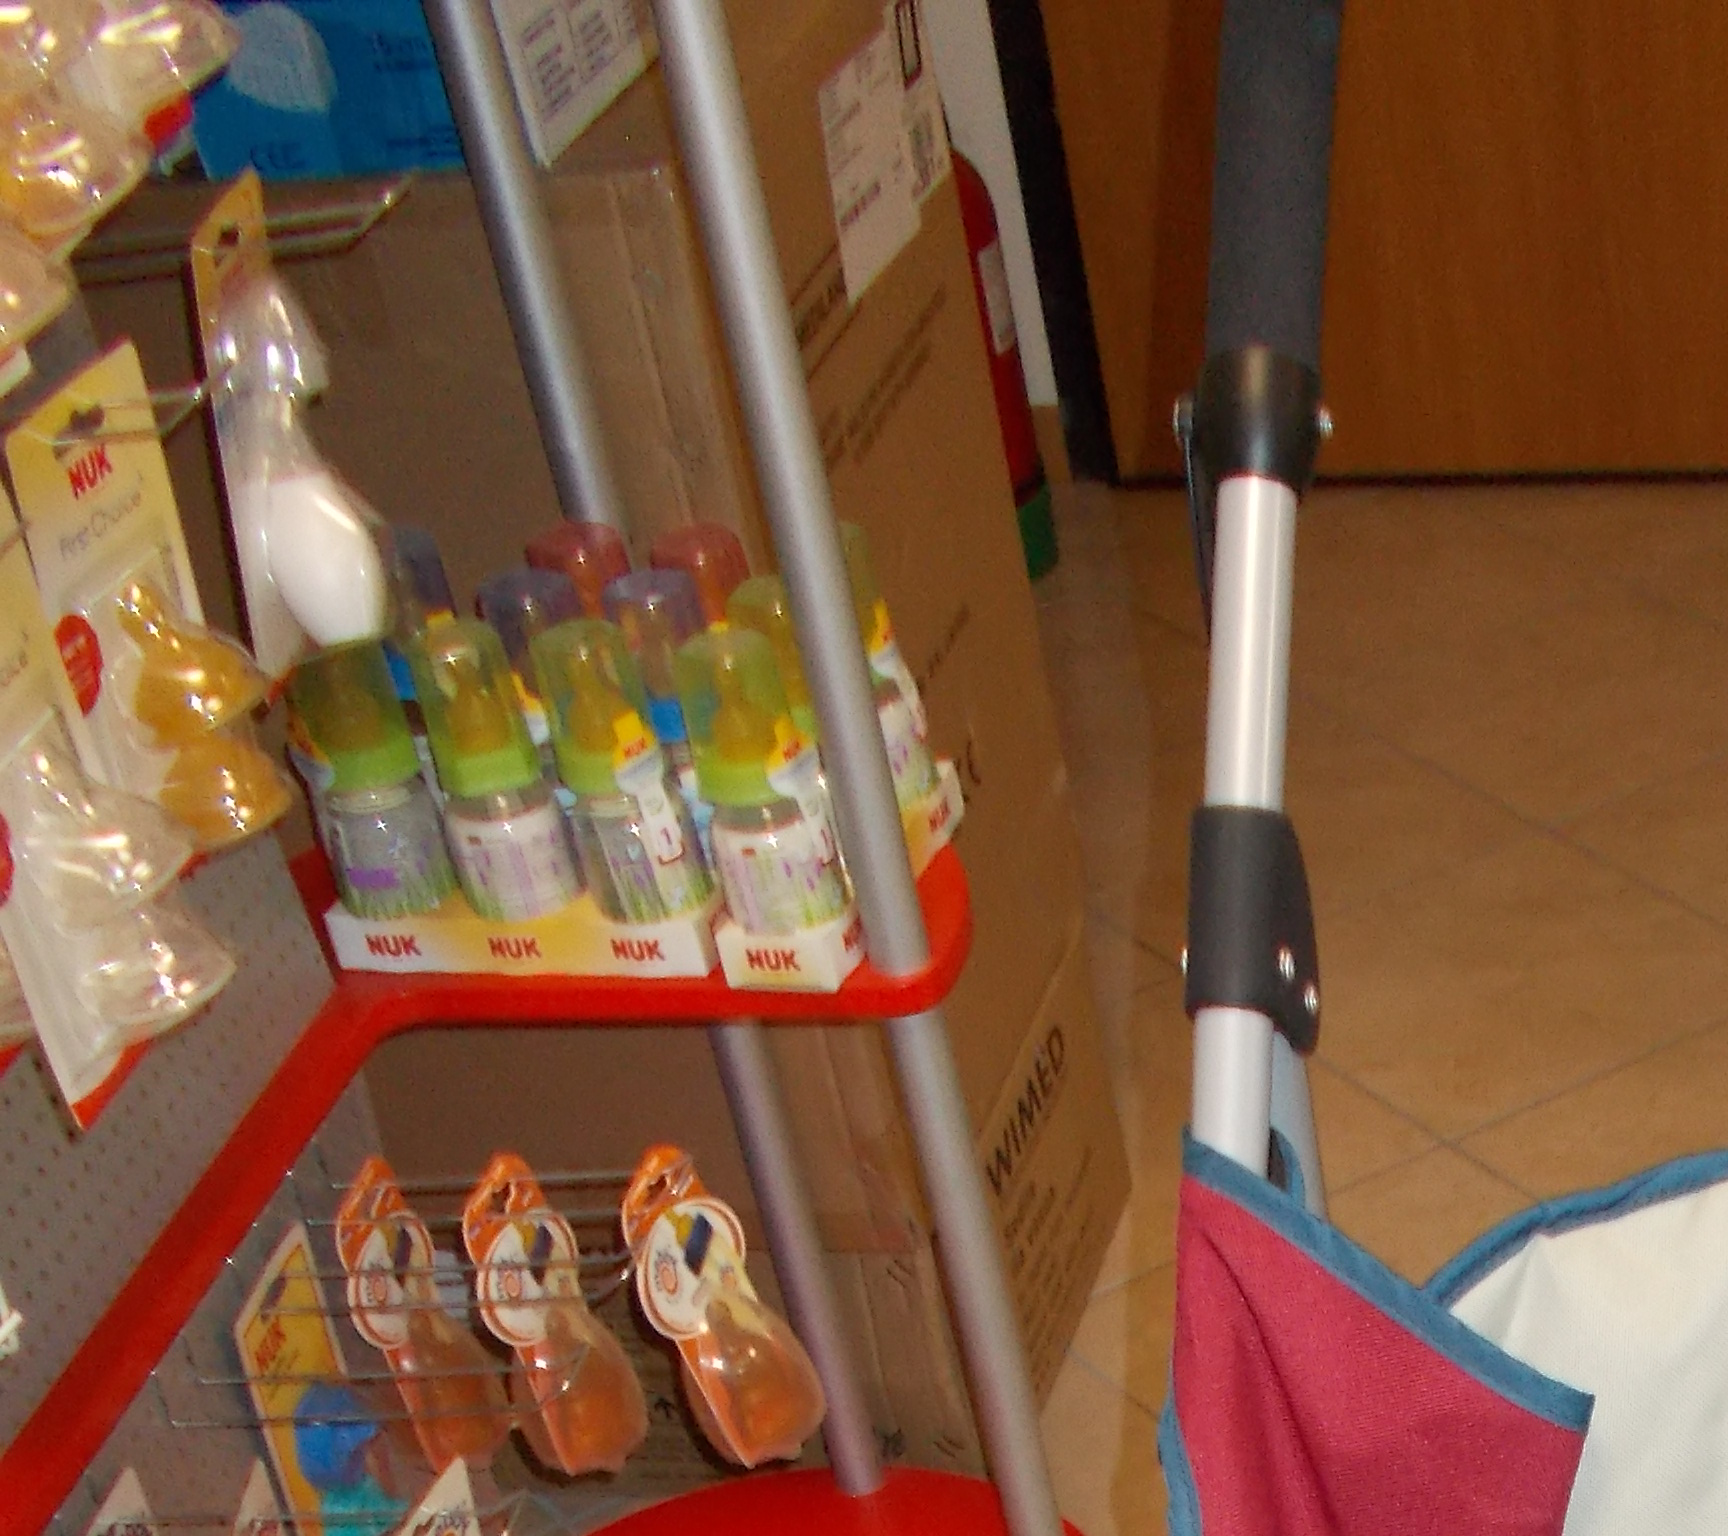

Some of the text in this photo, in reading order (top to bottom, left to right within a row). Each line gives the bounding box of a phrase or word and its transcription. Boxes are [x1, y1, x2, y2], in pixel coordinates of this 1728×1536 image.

[68, 442, 112, 499] NUK
[364, 933, 422, 957] NUK
[488, 936, 543, 959] NUK
[610, 938, 666, 962] NUK
[744, 949, 802, 973] NUK
[985, 1026, 1065, 1197] WIMED
